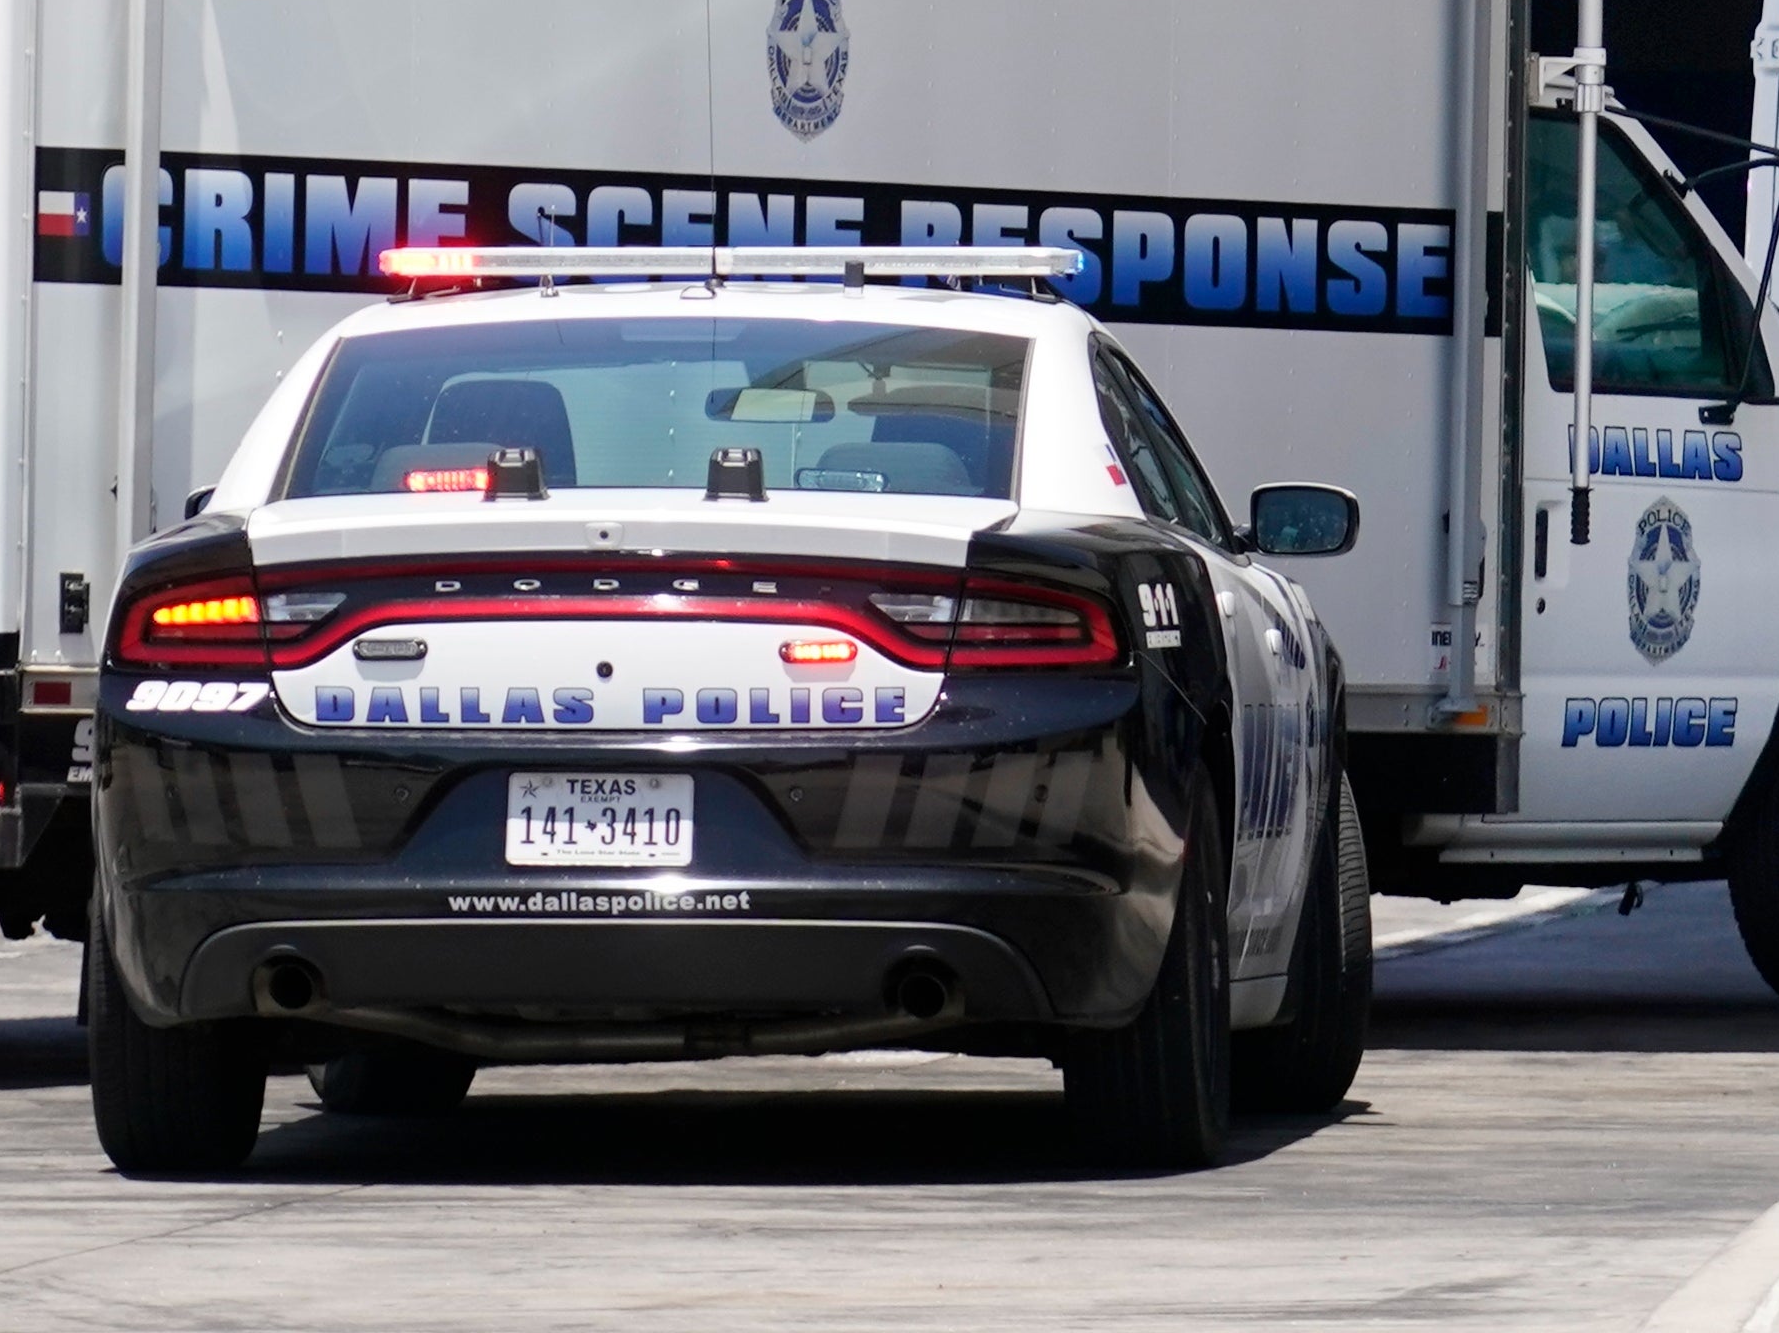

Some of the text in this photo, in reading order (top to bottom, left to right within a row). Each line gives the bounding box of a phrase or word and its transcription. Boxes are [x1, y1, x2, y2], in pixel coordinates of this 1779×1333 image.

[101, 164, 470, 277] CRIME
[435, 578, 778, 593] DODGE
[125, 679, 270, 712] 9097
[315, 686, 906, 724] DALLAS POLICE
[1561, 696, 1738, 748] POLICE
[566, 778, 637, 796] TEXAS
[580, 795, 621, 804] EXEMPT
[448, 890, 751, 915] www.dallaspolice.net
